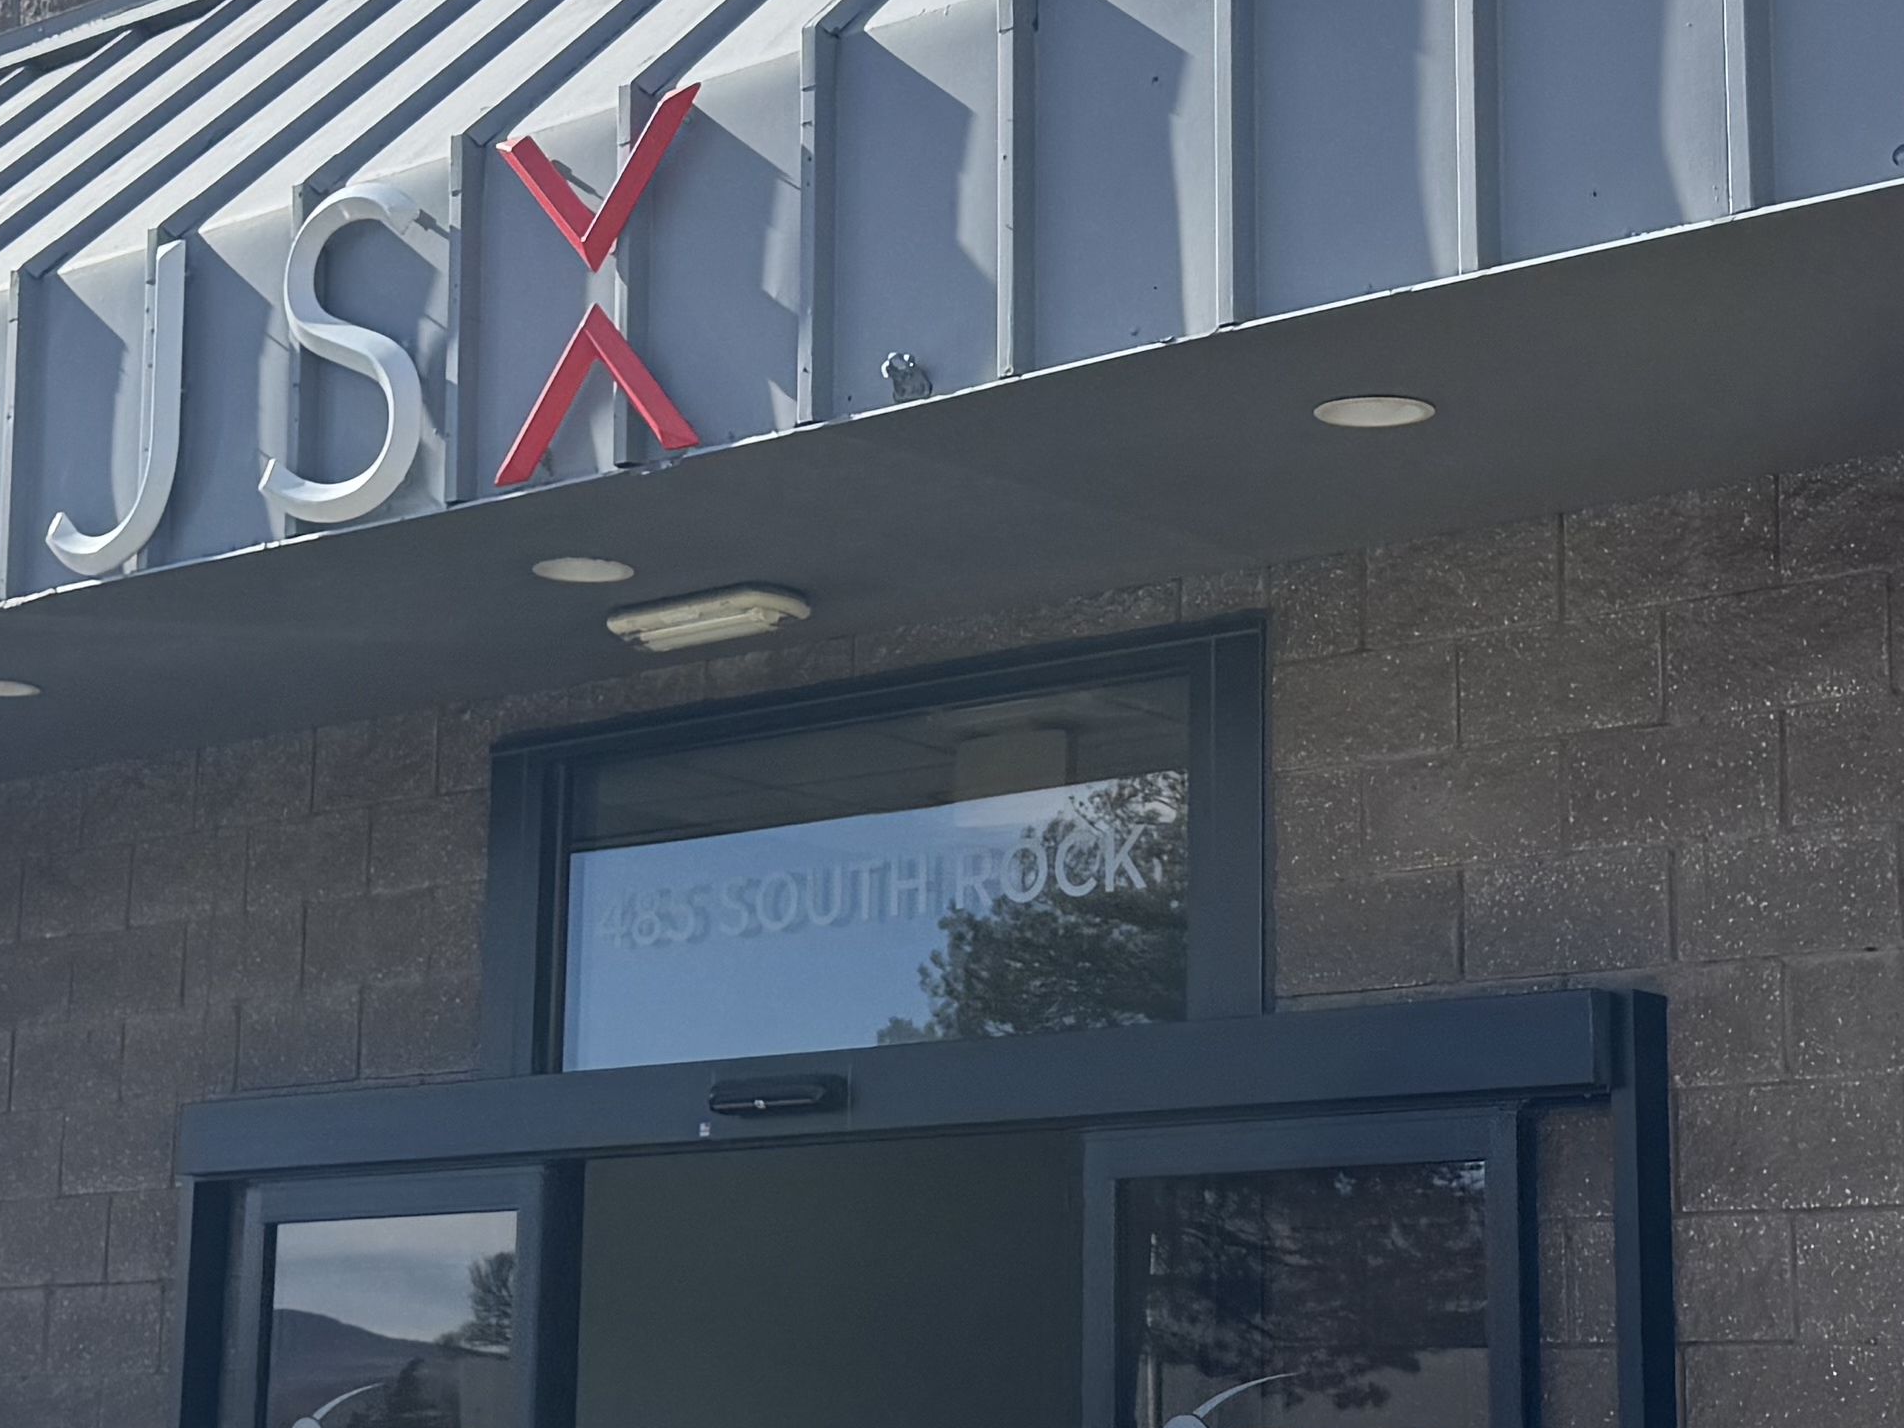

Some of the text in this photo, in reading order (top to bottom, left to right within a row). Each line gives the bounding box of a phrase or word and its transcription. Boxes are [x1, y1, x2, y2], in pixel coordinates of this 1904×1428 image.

[46, 82, 701, 576] JSX
[716, 852, 929, 936] SOUTH
[955, 824, 1148, 909] ROCK
